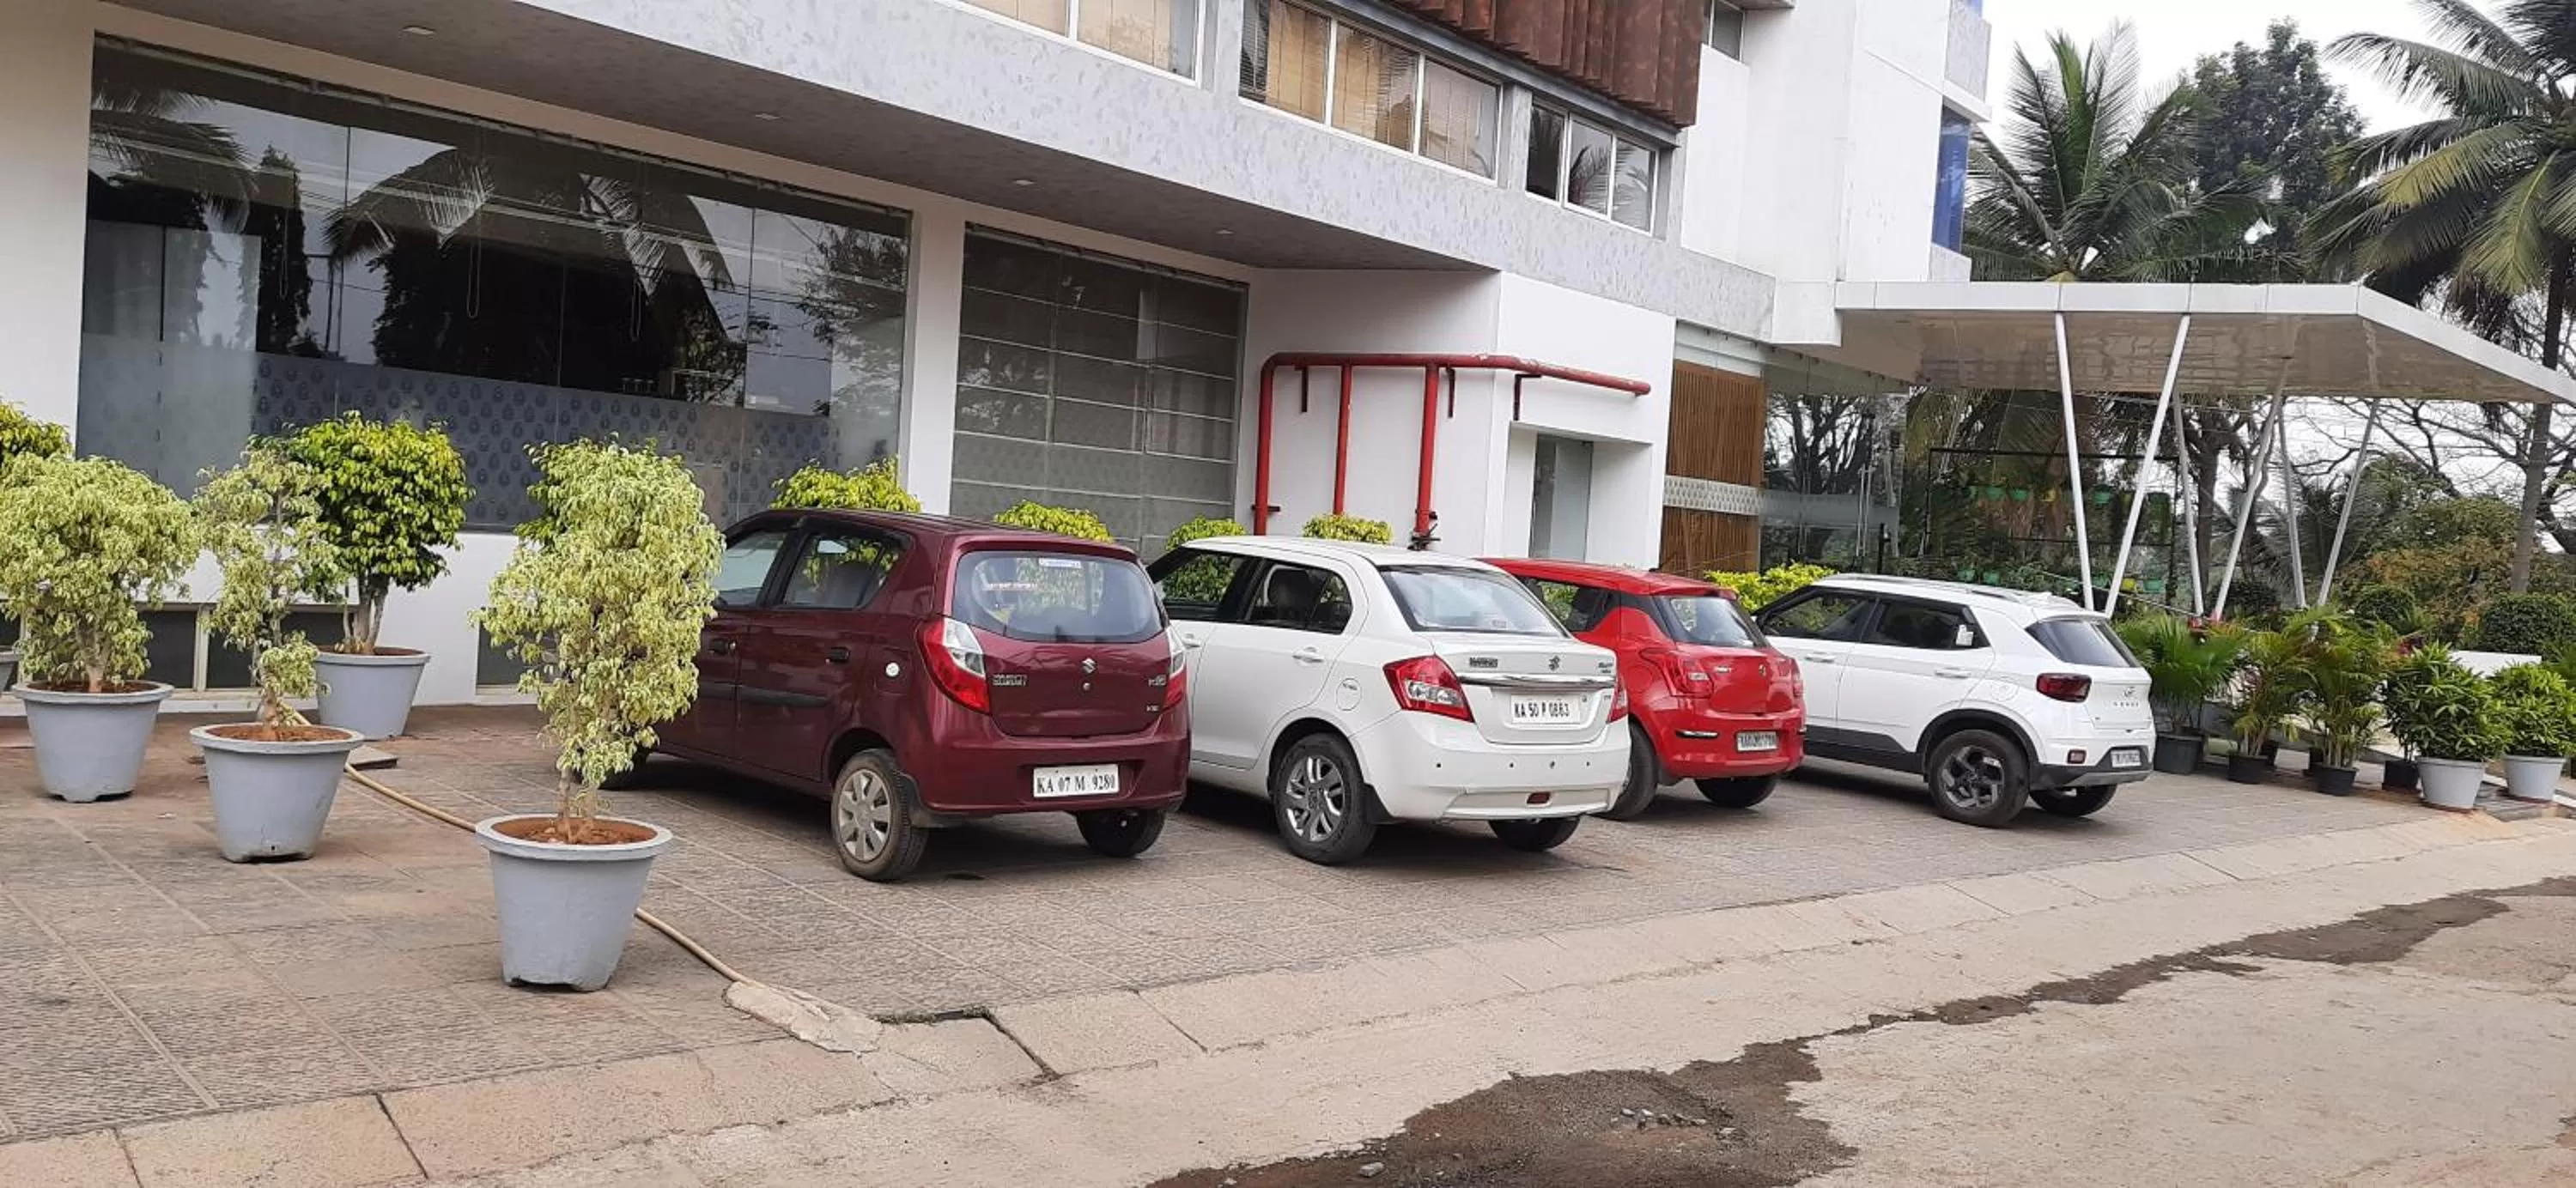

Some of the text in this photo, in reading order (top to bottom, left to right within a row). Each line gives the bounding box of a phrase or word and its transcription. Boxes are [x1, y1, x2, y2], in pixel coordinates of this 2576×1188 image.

[1514, 703, 1526, 718] KA
[1528, 702, 1539, 717] 50
[1541, 702, 1546, 717] P
[1036, 774, 1115, 793] KA 07 M 9280
